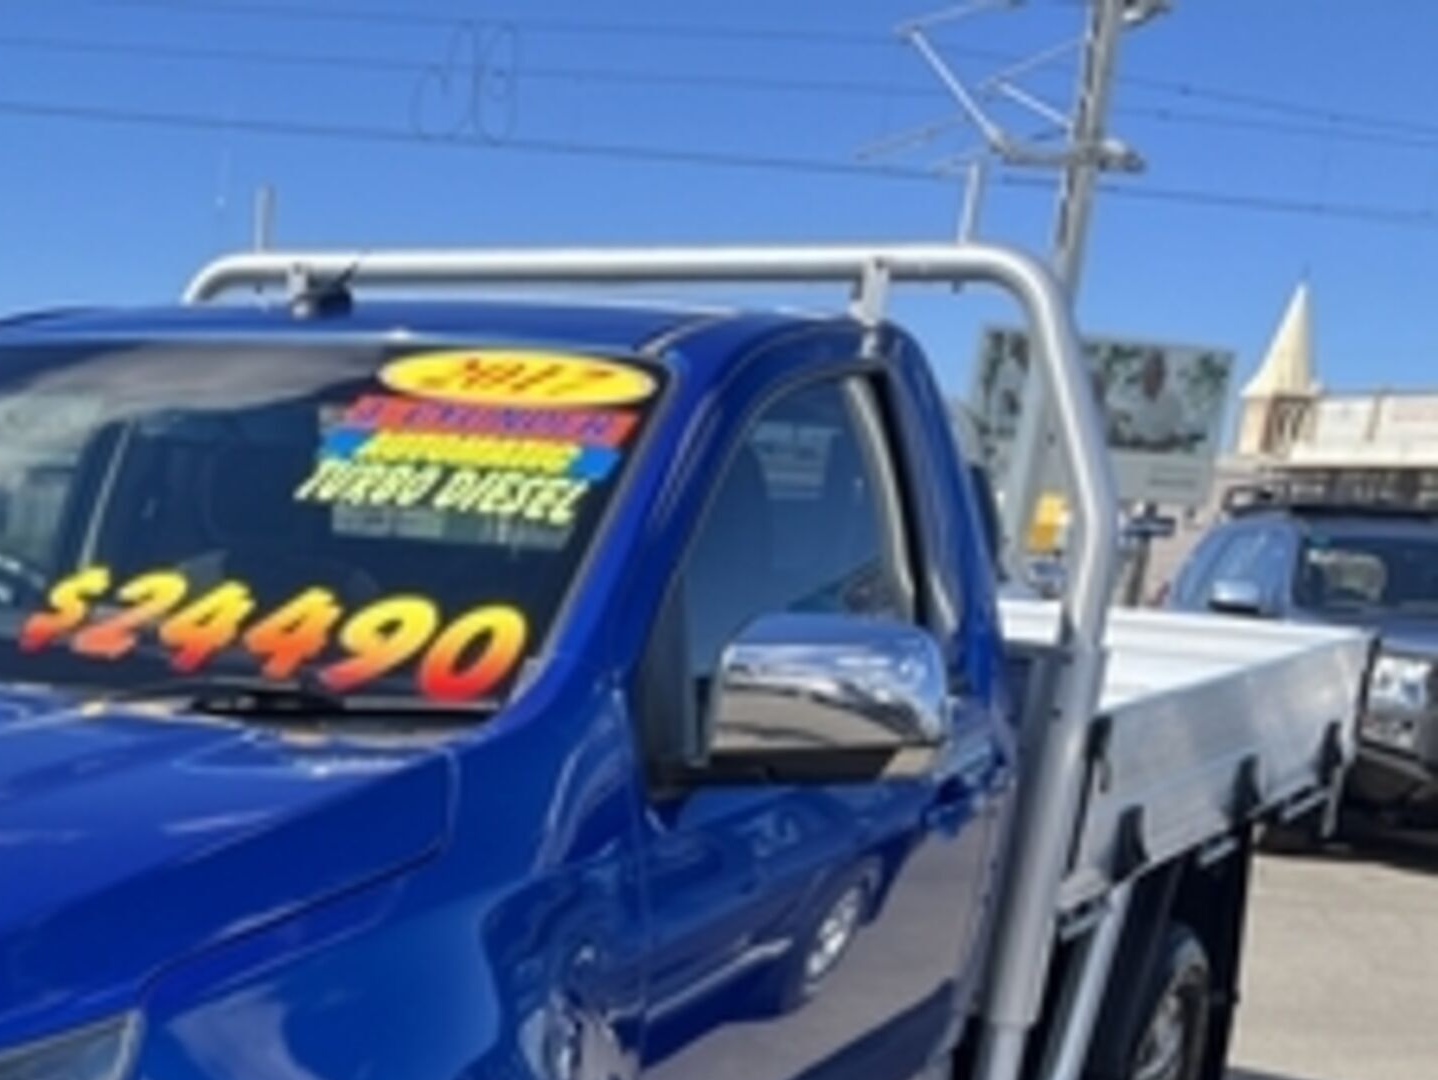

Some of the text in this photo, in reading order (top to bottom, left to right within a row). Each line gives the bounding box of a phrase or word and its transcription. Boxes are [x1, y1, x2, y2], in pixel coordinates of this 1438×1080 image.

[418, 358, 615, 397] 2017
[294, 460, 589, 525] TURBO DIESEL
[19, 566, 526, 700] $24490
